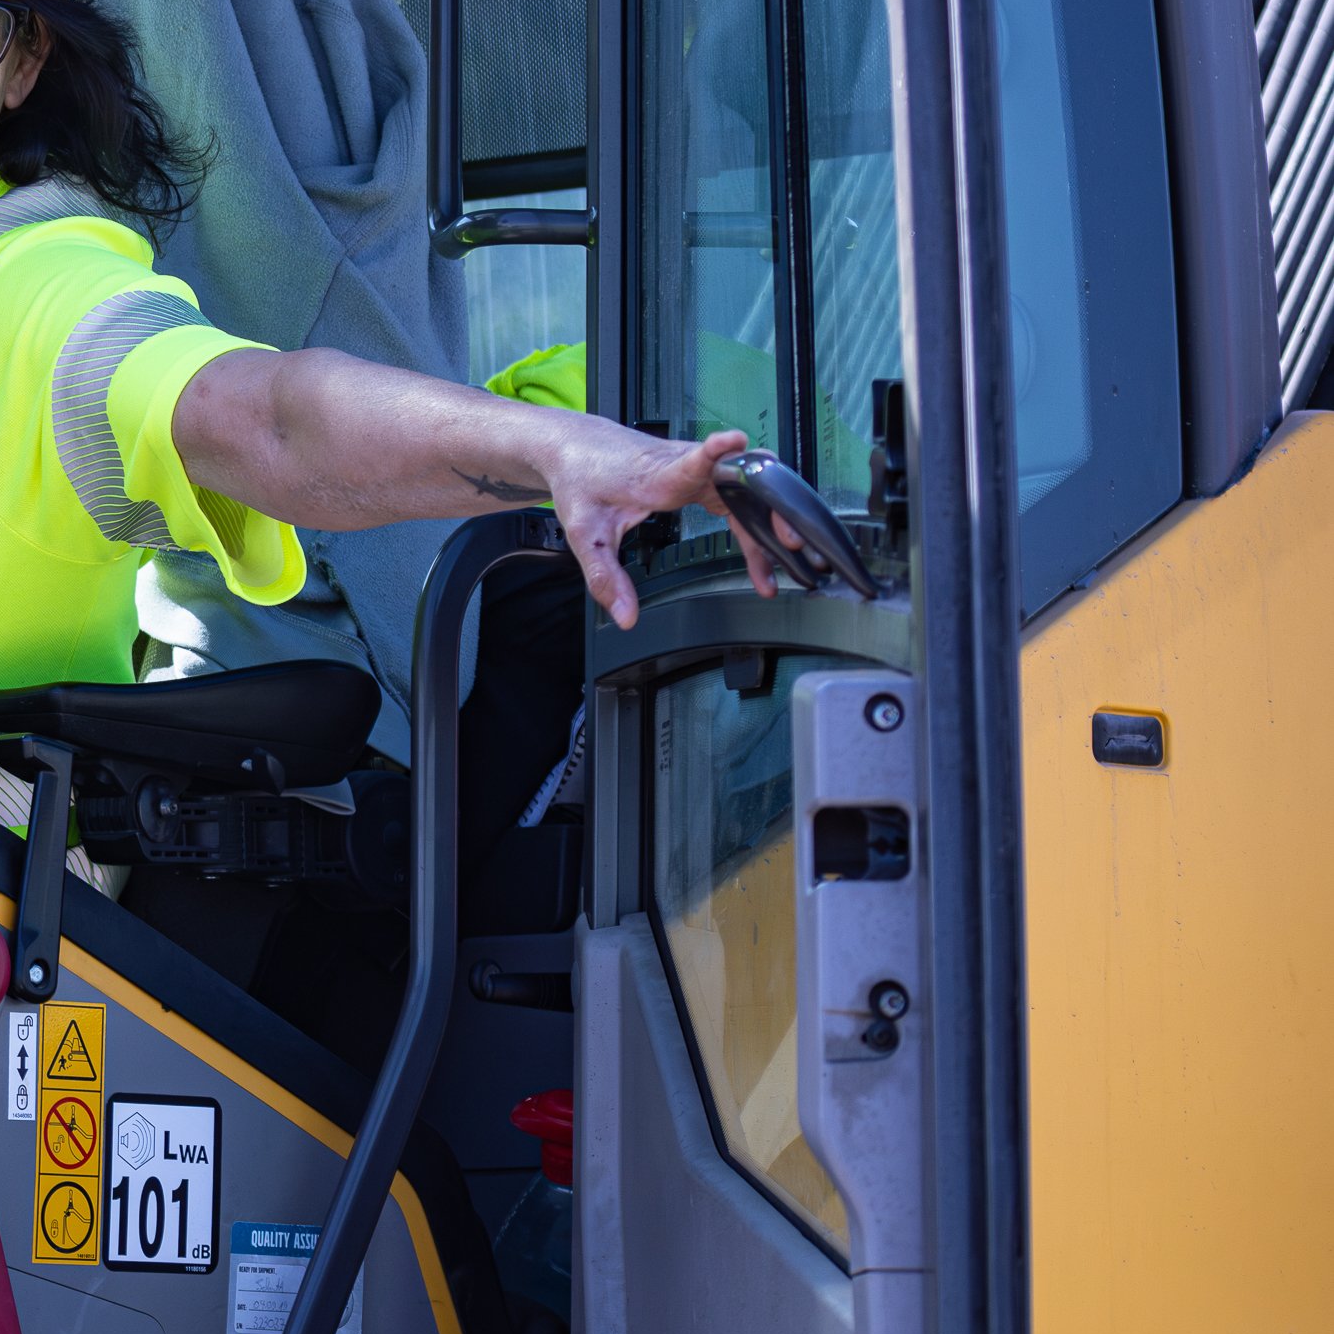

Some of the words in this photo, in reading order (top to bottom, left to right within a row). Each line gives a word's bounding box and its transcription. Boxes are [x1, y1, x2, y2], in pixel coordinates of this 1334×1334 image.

[163, 1130, 209, 1165] LWA
[112, 1176, 190, 1259] 101
[192, 1244, 211, 1259] dB
[251, 1229, 291, 1248] QUALITY
[293, 1232, 320, 1250] ASSU
[238, 1265, 250, 1273] READY
[250, 1266, 258, 1274] FOR
